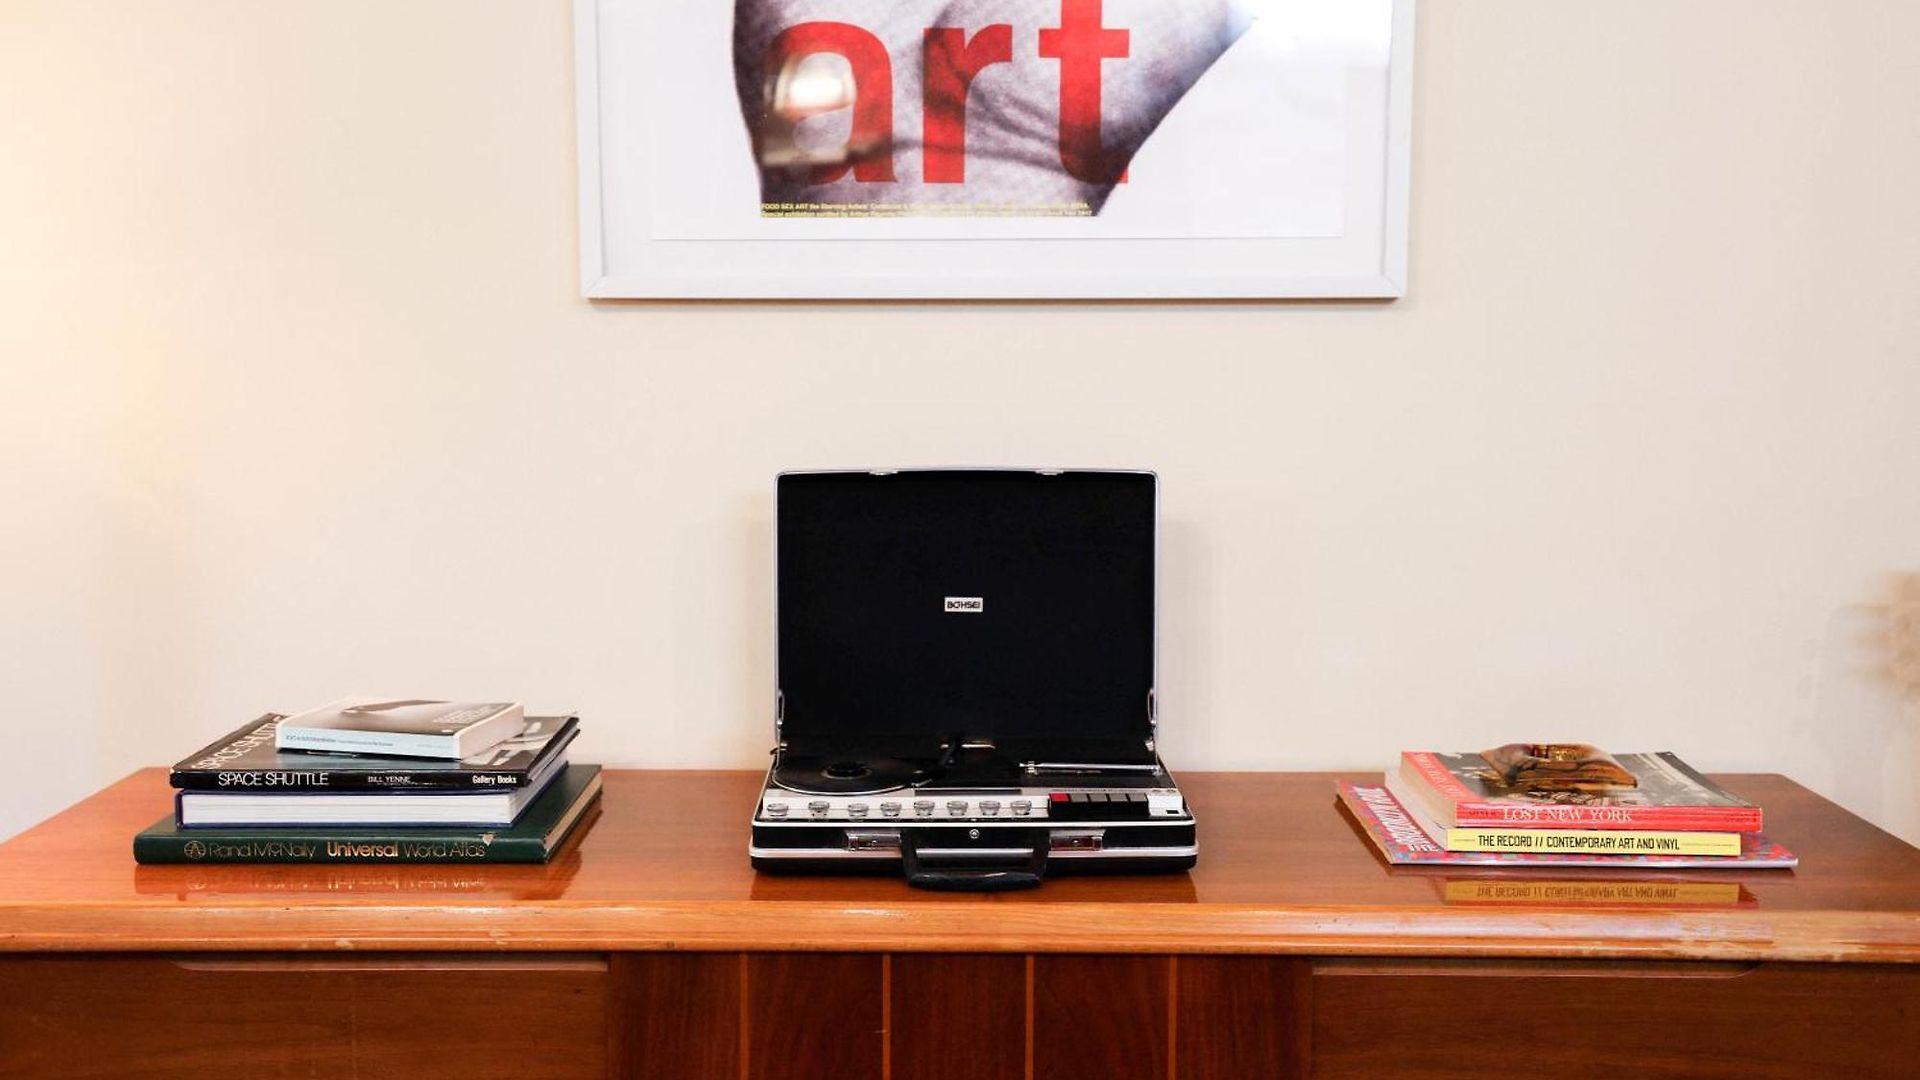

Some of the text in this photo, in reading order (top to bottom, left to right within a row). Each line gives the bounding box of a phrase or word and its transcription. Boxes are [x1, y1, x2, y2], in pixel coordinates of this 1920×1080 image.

[763, 0, 1131, 185] art
[218, 772, 330, 786] SPACE SHUTTLE
[472, 775, 517, 785] Gallery Books
[1503, 808, 1632, 821] LOST NEW YORK
[210, 843, 250, 857] Rand
[327, 841, 398, 857] Universal
[404, 843, 446, 857] World
[451, 843, 486, 857] Atlas
[1478, 835, 1494, 847] THE
[1497, 835, 1532, 847] RECORD
[1546, 836, 1616, 848] CONTEMPORARY
[1618, 838, 1635, 848] ART
[1636, 838, 1654, 849] AND
[1657, 839, 1680, 850] VINYL
